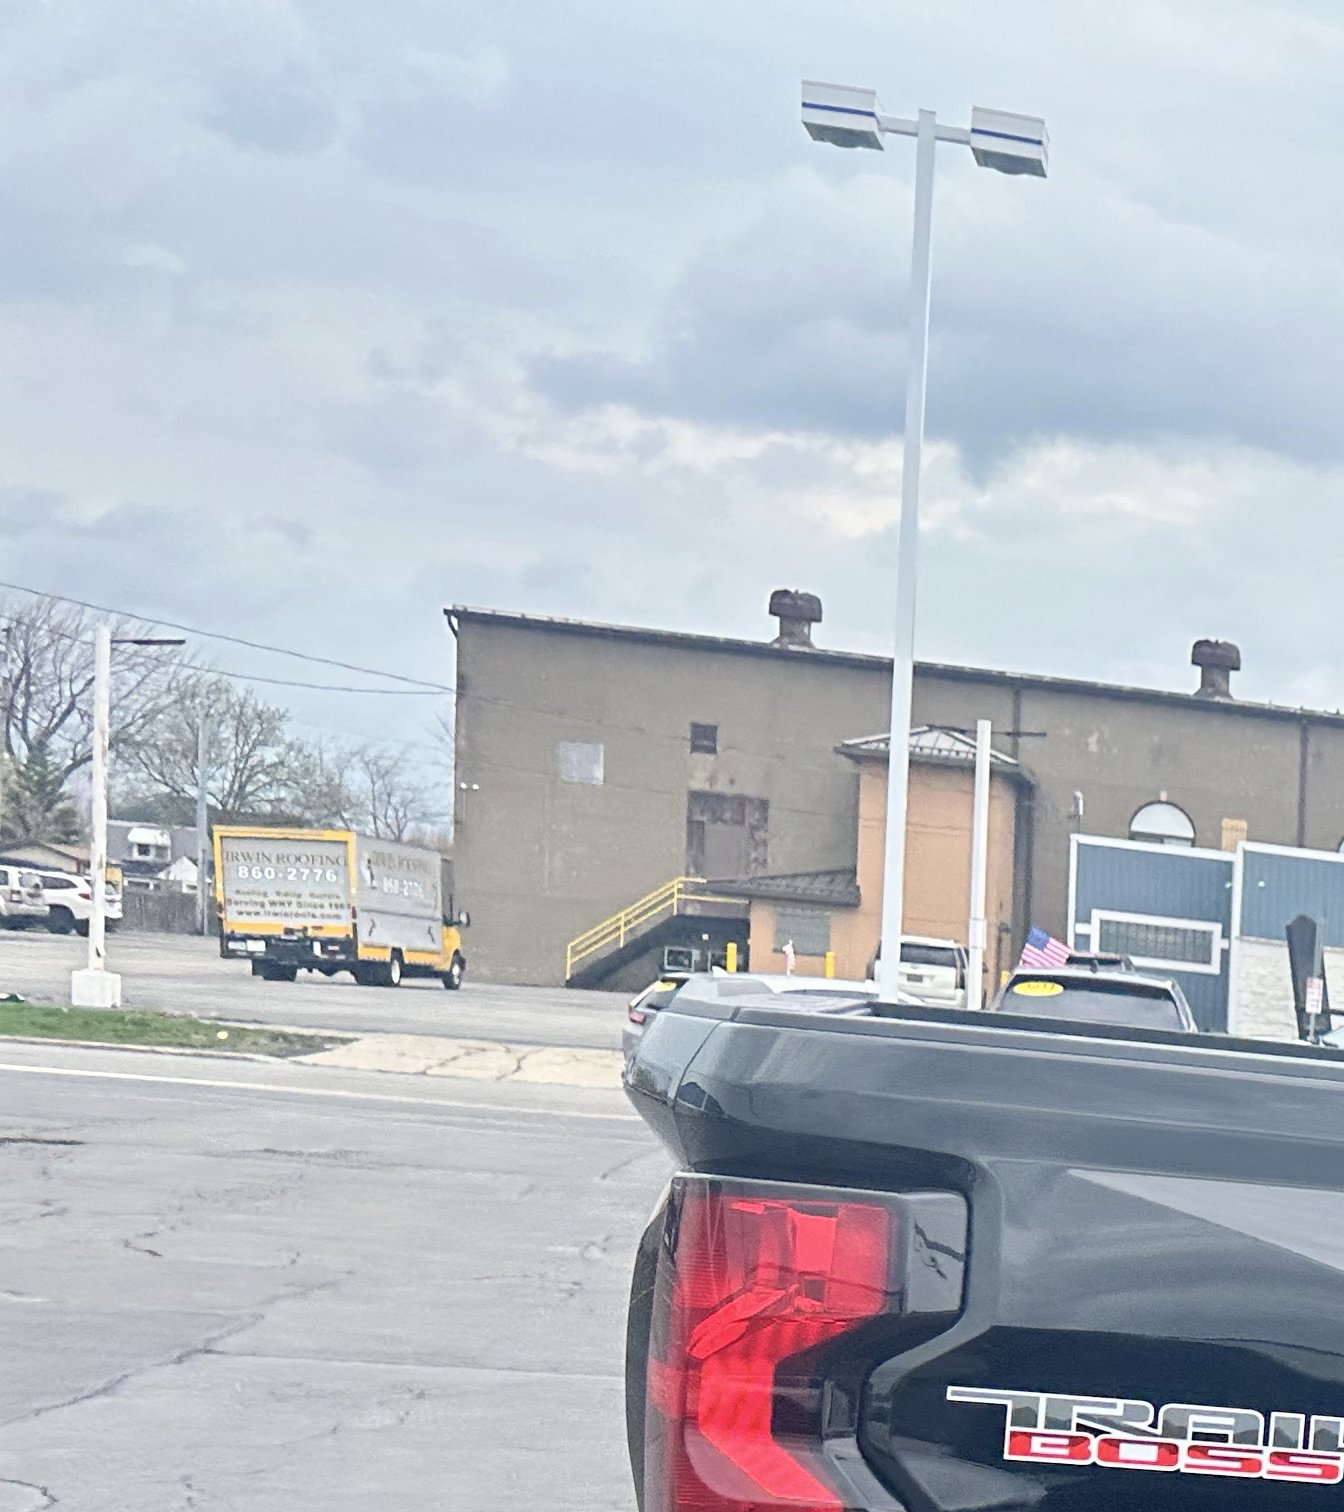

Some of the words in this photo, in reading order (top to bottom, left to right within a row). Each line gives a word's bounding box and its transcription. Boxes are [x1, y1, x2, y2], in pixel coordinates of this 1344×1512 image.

[225, 851, 272, 864] IRWIN
[238, 866, 337, 882] 860-2776
[1003, 1429, 1344, 1484] BOSS
